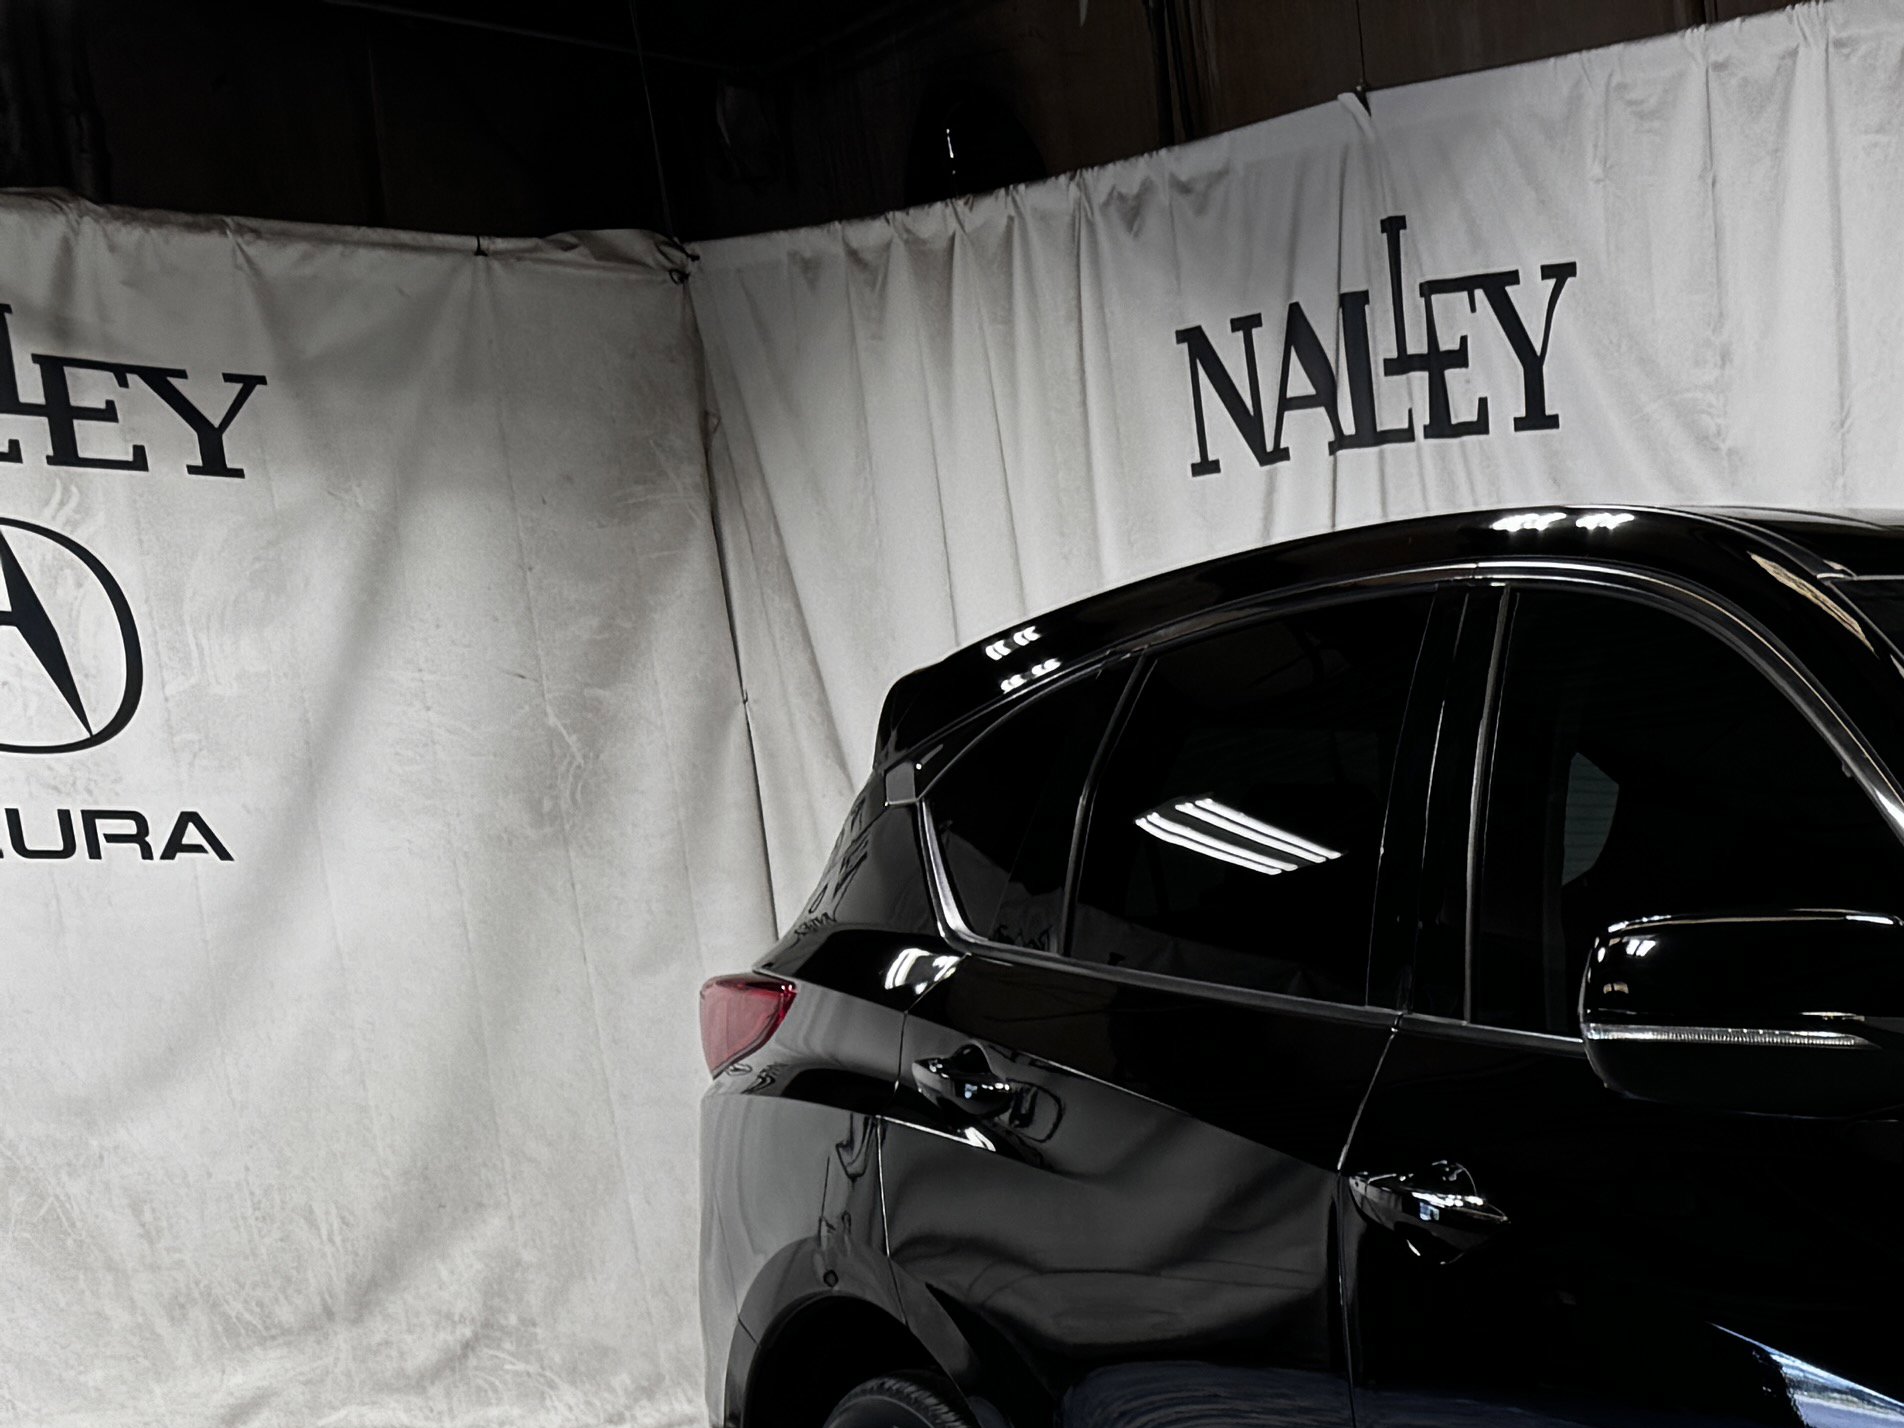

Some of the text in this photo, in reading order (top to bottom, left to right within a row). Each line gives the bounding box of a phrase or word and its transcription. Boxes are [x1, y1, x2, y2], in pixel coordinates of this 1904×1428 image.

[0, 303, 268, 479] LEY
[1175, 214, 1577, 477] NALLEY
[0, 807, 235, 862] URA
